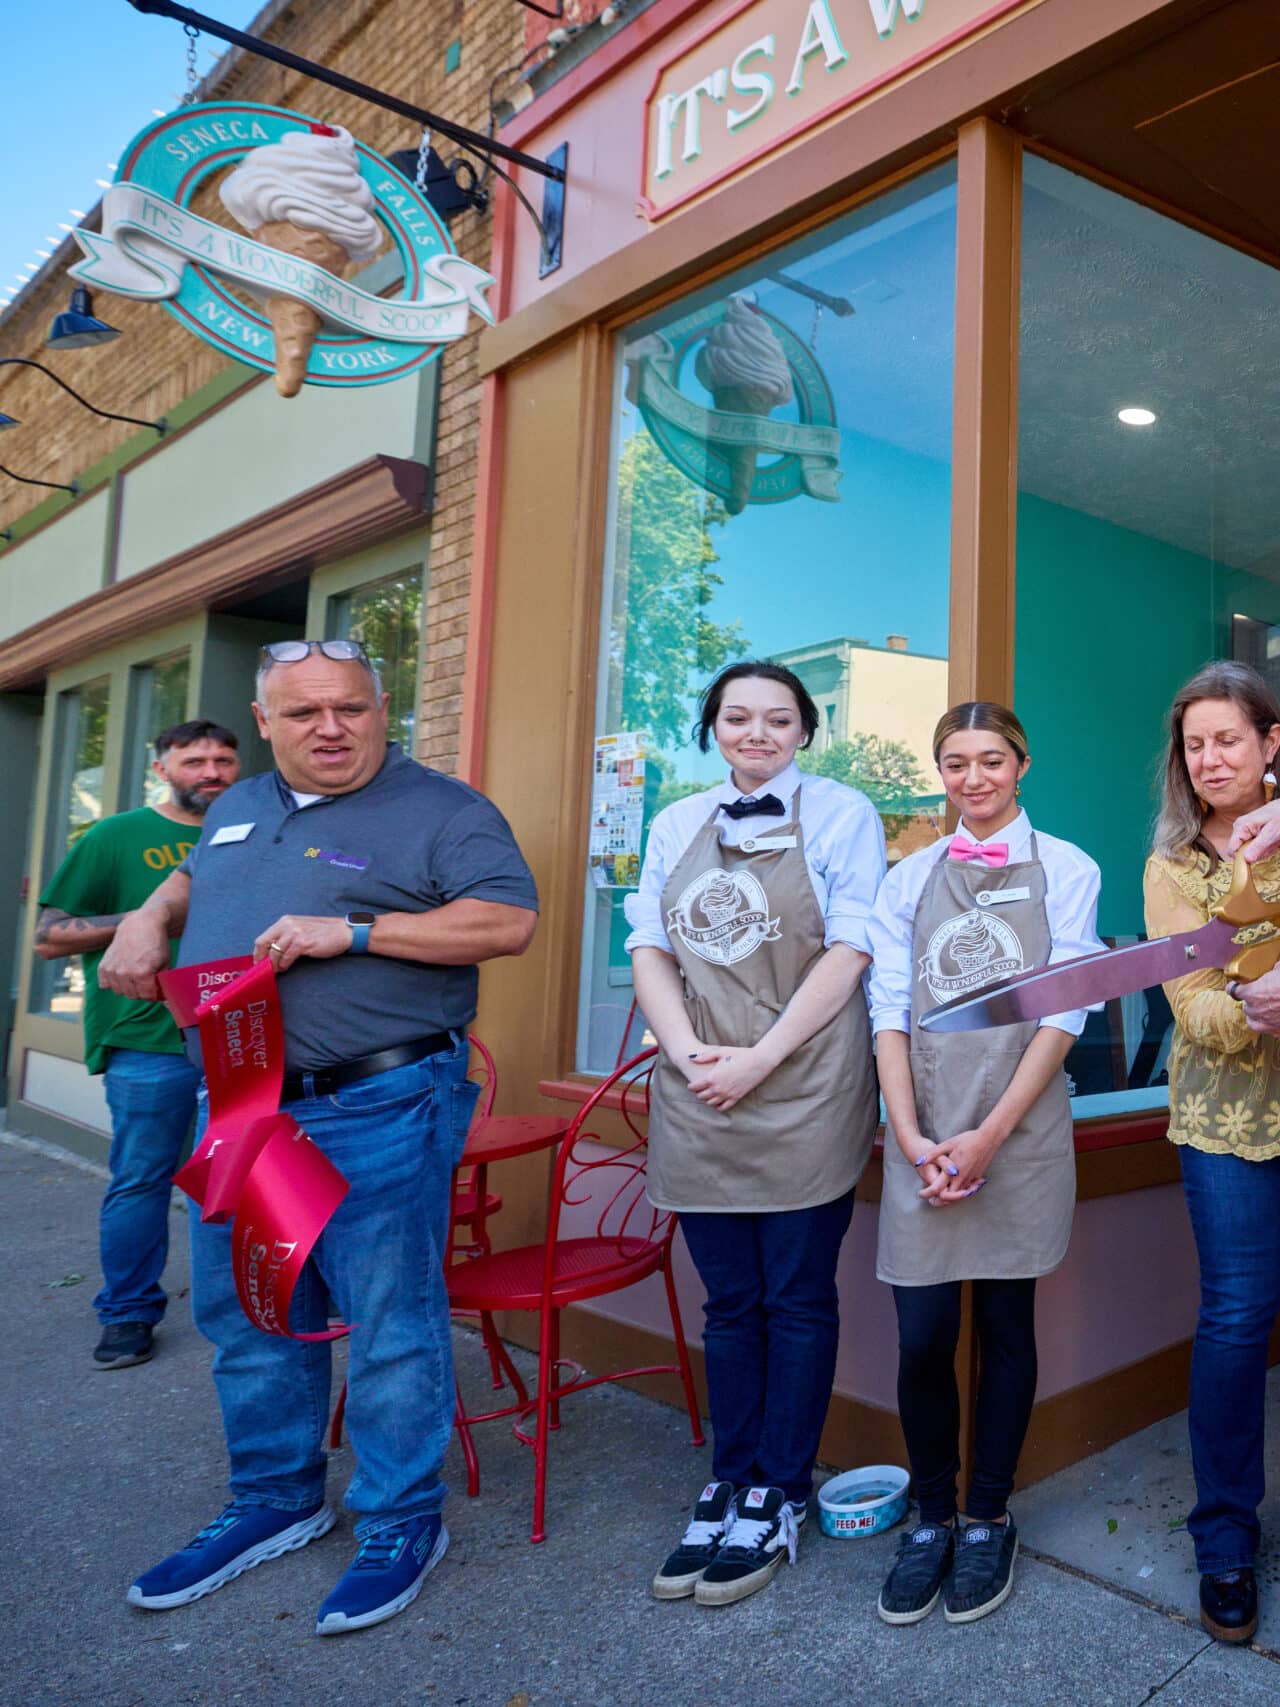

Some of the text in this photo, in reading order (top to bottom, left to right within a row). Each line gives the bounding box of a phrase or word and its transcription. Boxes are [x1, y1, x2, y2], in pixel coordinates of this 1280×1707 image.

[654, 0, 849, 181] IT'S A
[165, 119, 436, 248] SENECA FALLS
[140, 198, 454, 333] IT'S A WONDERFUL SCOOP
[197, 300, 398, 371] NEW YORK
[994, 960, 1017, 973] SCOOP
[224, 1009, 245, 1068] Seneca
[244, 1000, 268, 1068] Discover
[836, 1516, 875, 1530] FEED ME!
